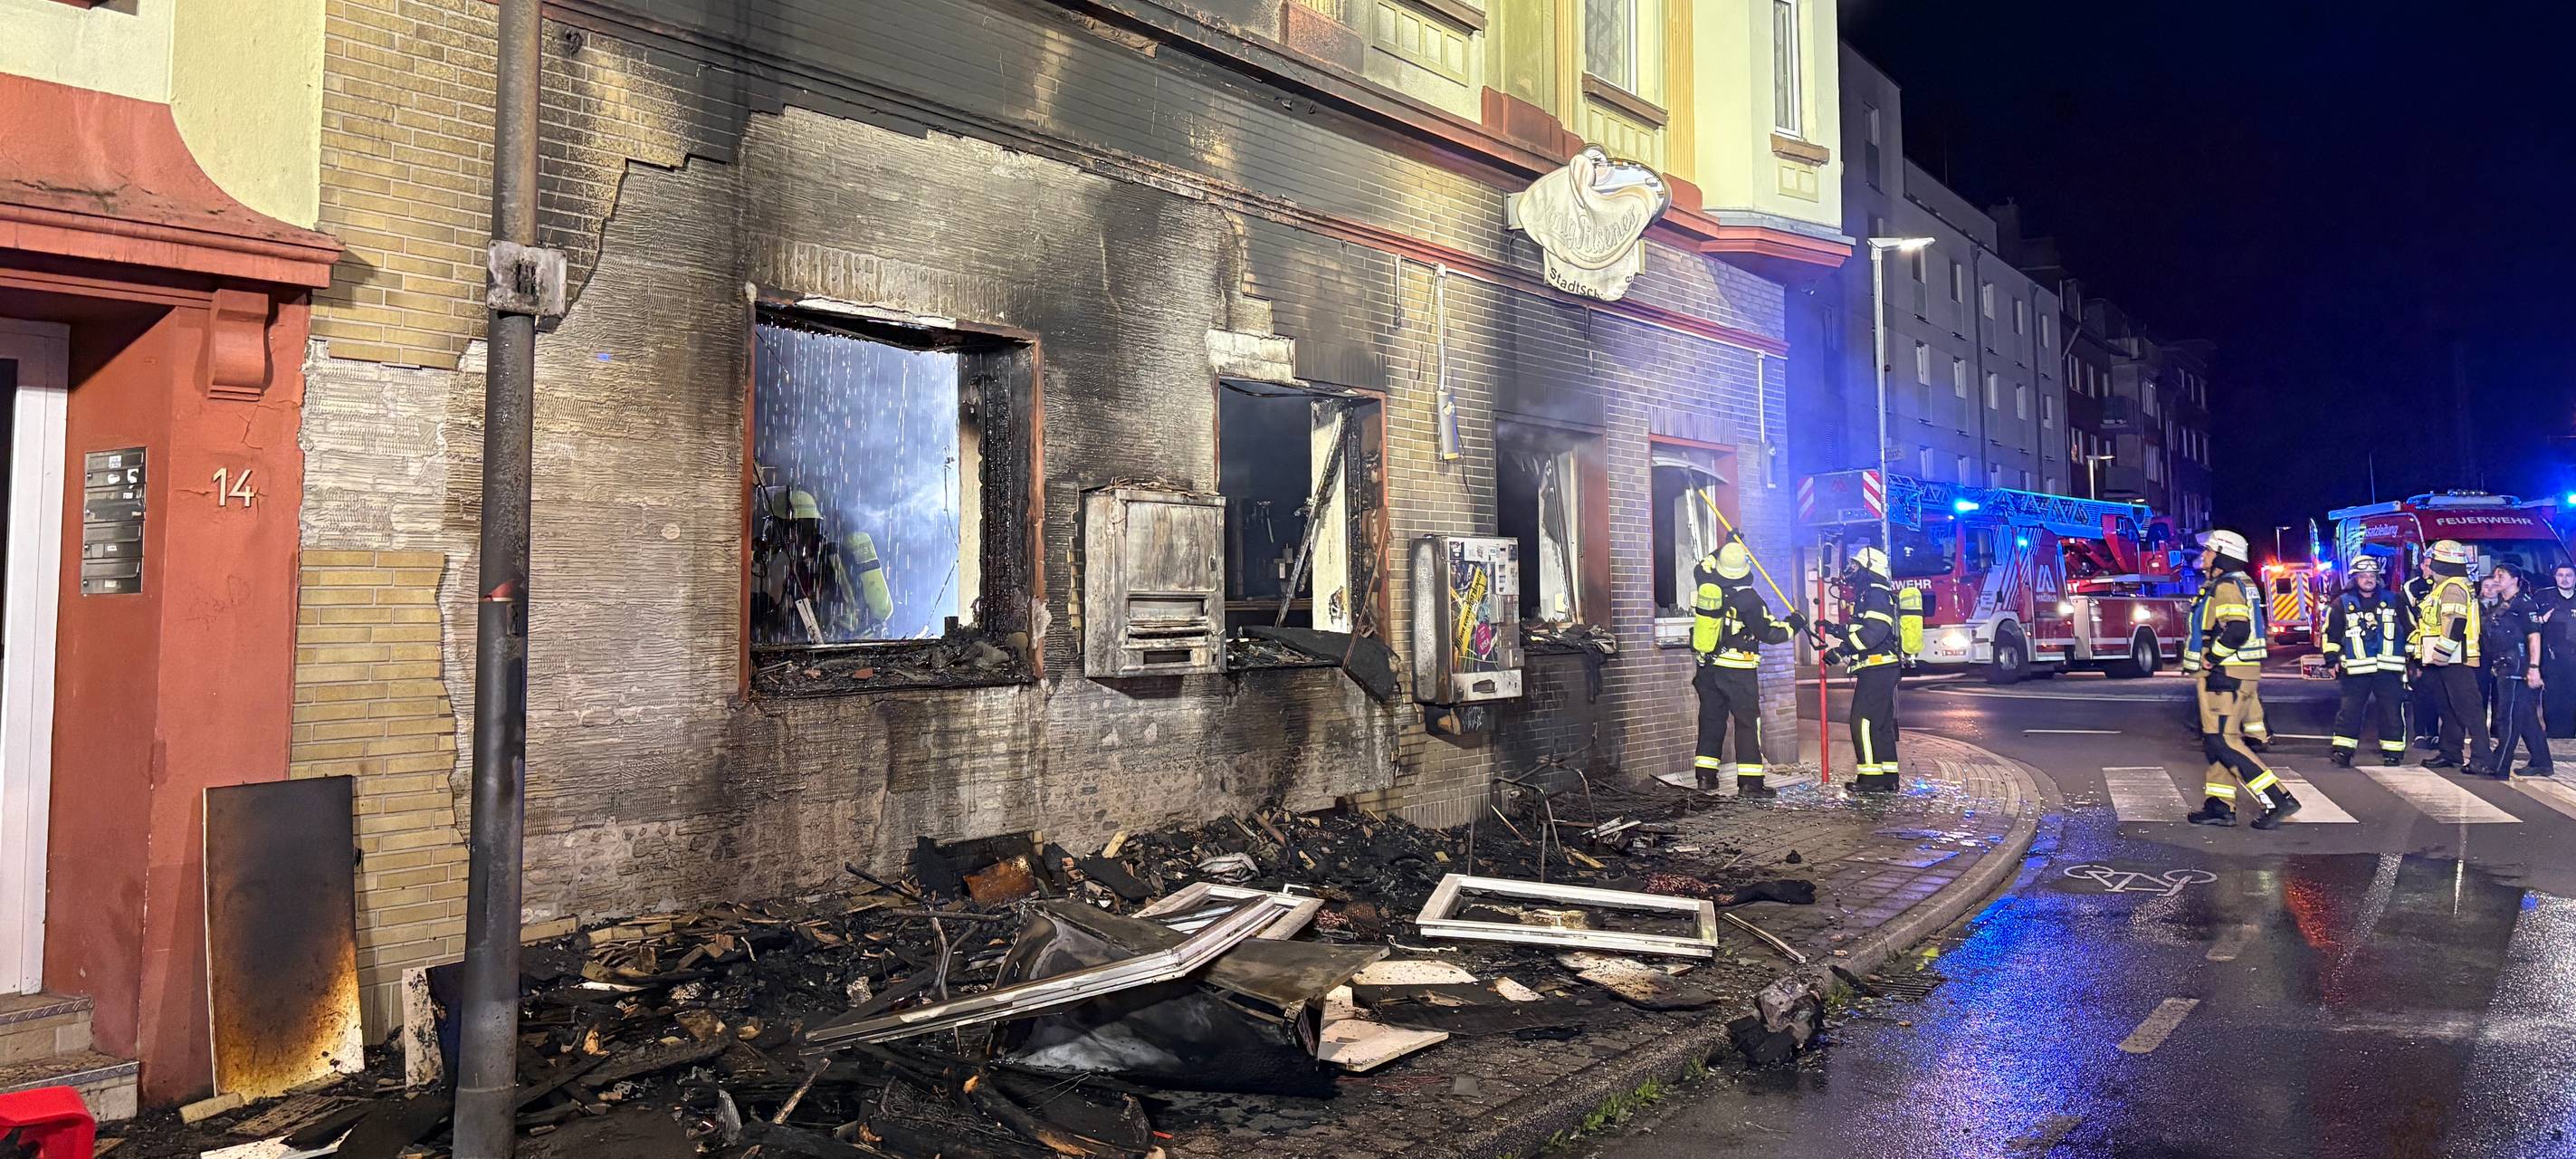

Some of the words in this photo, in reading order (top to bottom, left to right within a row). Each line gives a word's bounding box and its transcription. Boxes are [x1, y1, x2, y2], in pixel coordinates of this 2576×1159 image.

[1550, 267, 1633, 300] Stadtsche
[213, 467, 255, 507] 14
[2436, 516, 2533, 525] FEUERWEHR
[1891, 579, 1932, 589] RWEHR
